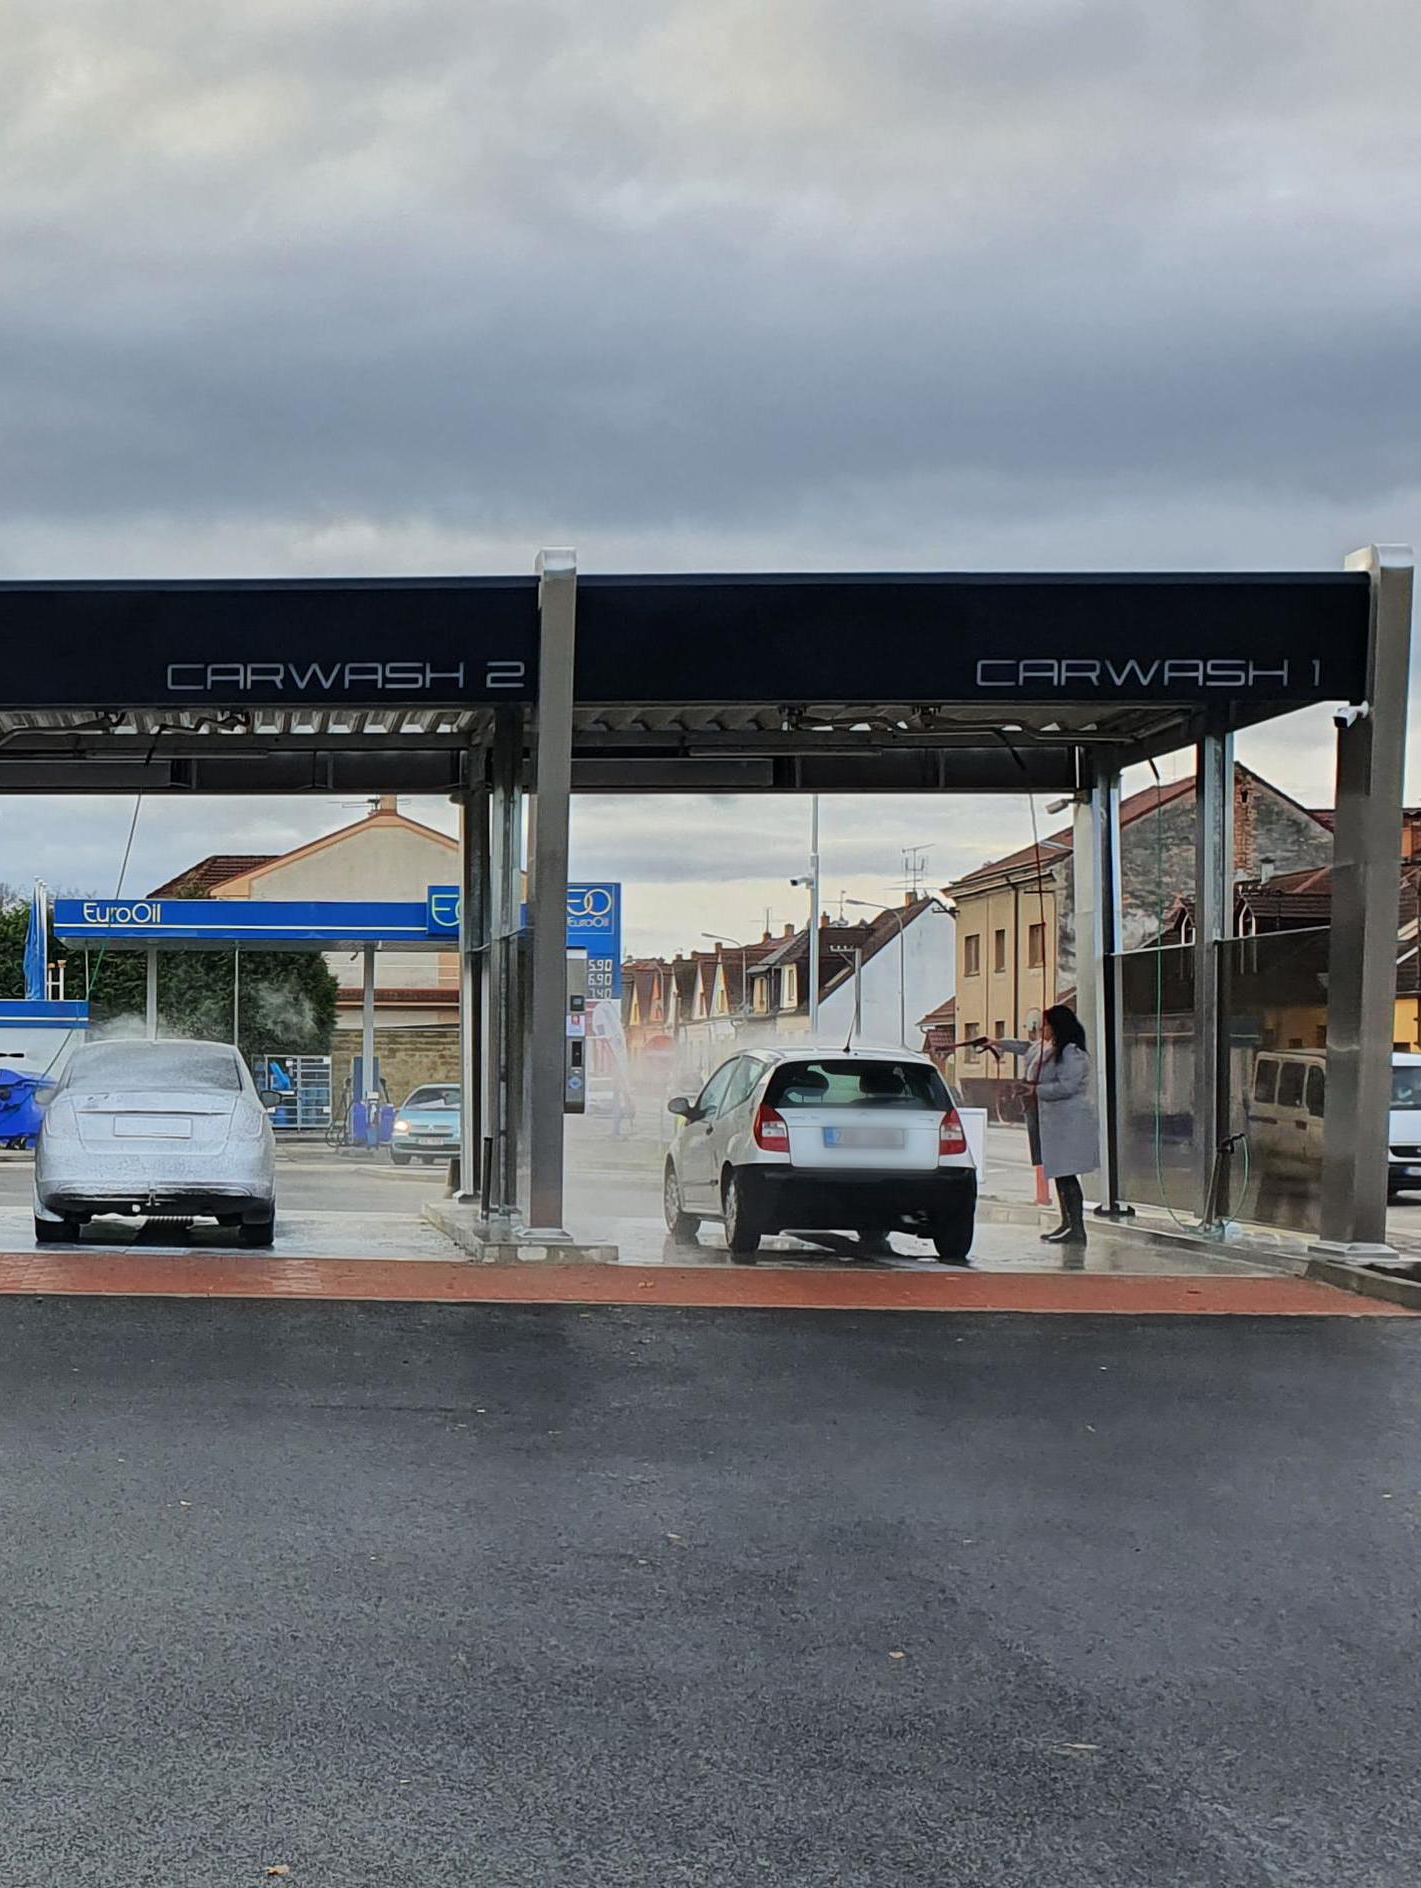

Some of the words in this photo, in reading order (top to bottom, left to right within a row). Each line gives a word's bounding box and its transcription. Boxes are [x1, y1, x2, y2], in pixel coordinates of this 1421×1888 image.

[166, 661, 465, 690] CARWASH
[486, 661, 525, 688] 2
[976, 659, 1288, 687] CARWASH
[1312, 659, 1320, 686] 1
[83, 902, 161, 923] EuroOil
